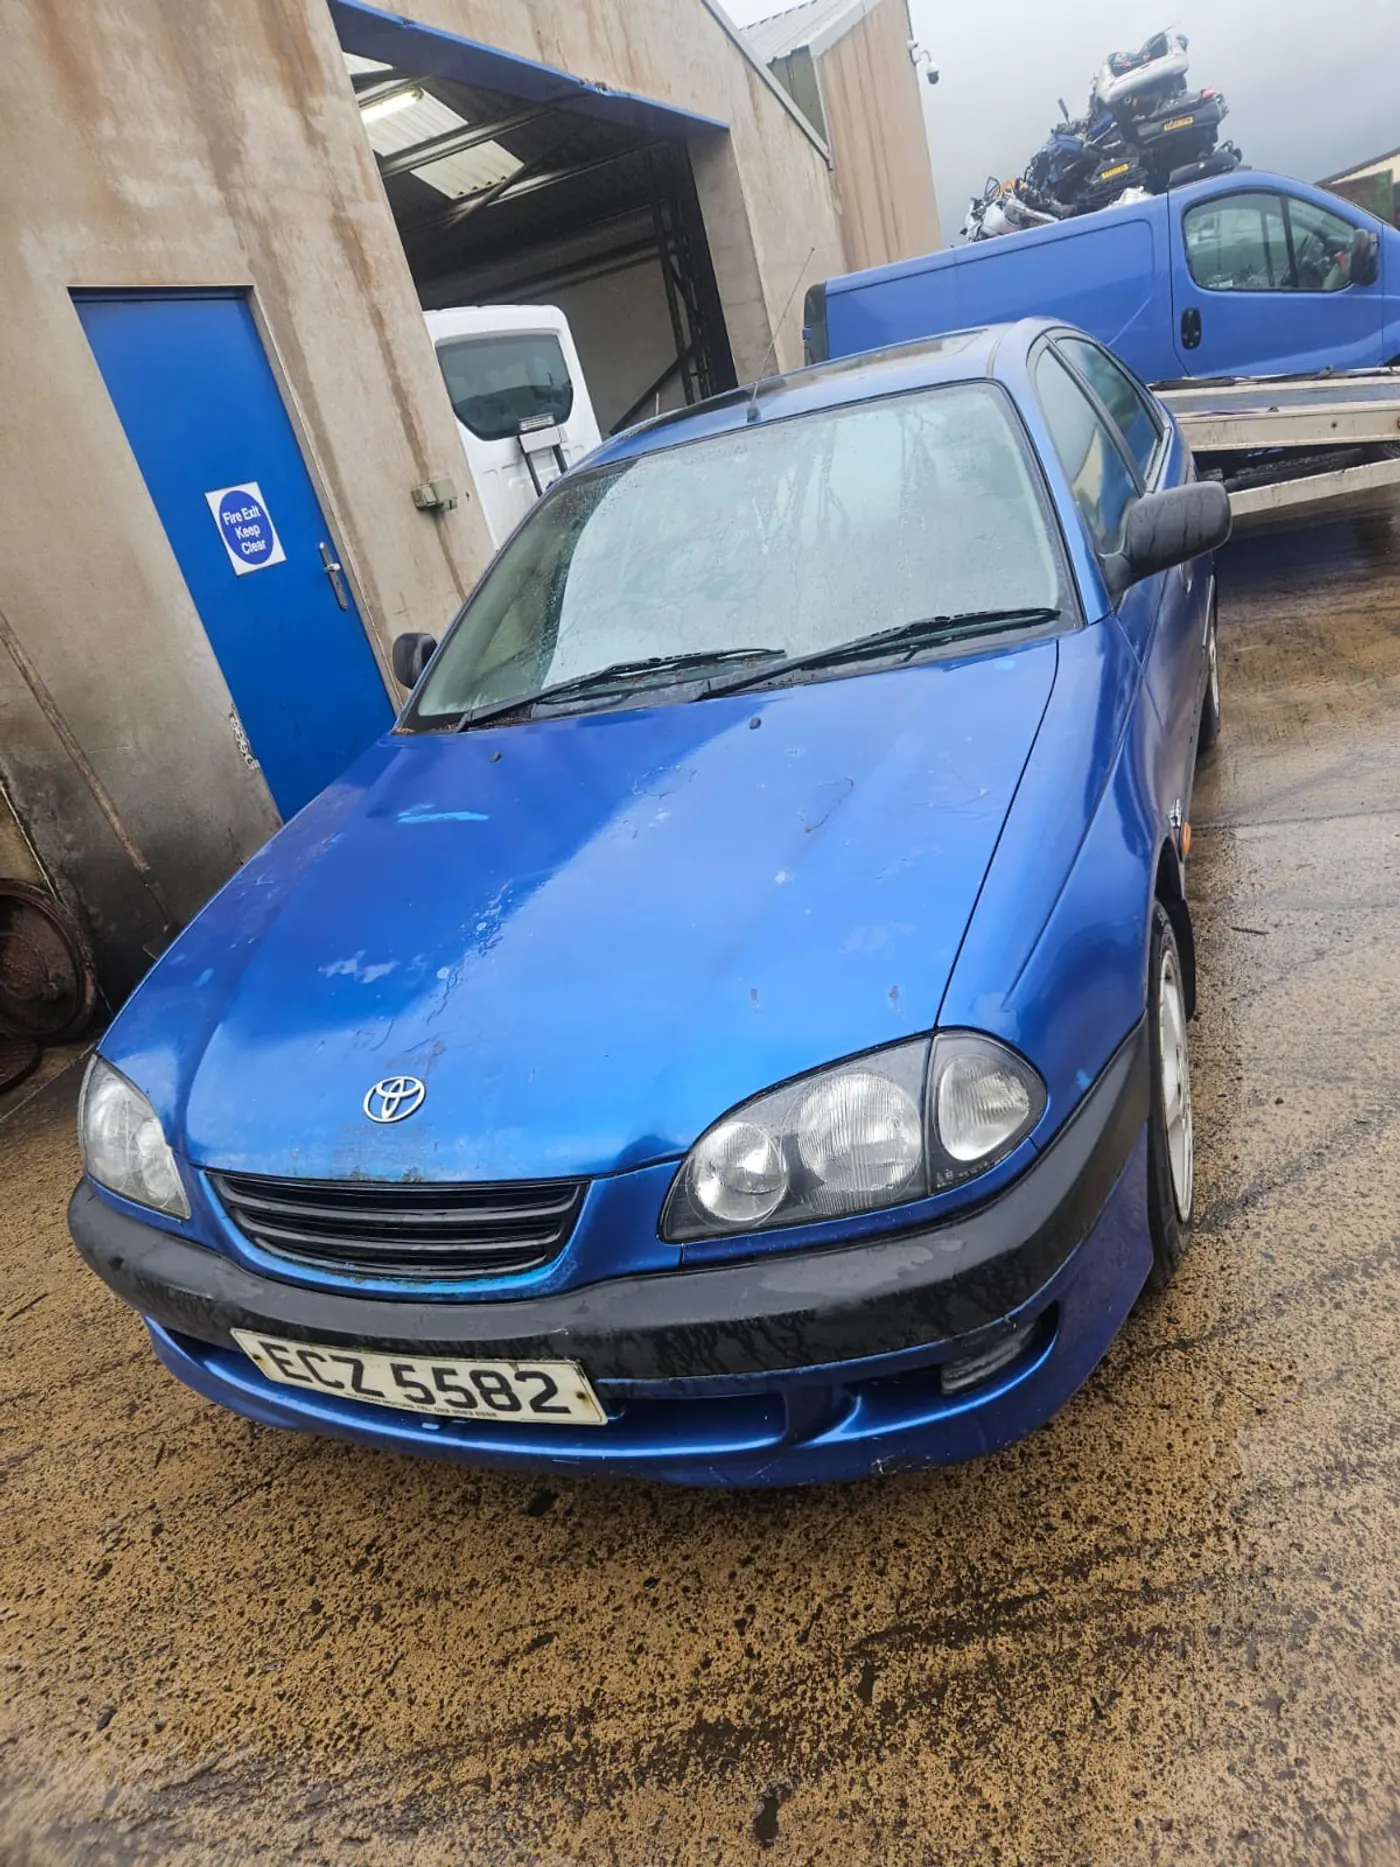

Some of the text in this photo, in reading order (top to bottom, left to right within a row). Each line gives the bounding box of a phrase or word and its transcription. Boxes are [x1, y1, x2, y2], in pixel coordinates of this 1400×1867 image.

[222, 505, 261, 525] Fire Exit
[235, 524, 261, 539] Keep
[241, 540, 266, 555] Clear
[258, 1341, 571, 1414] ECZ 5582
